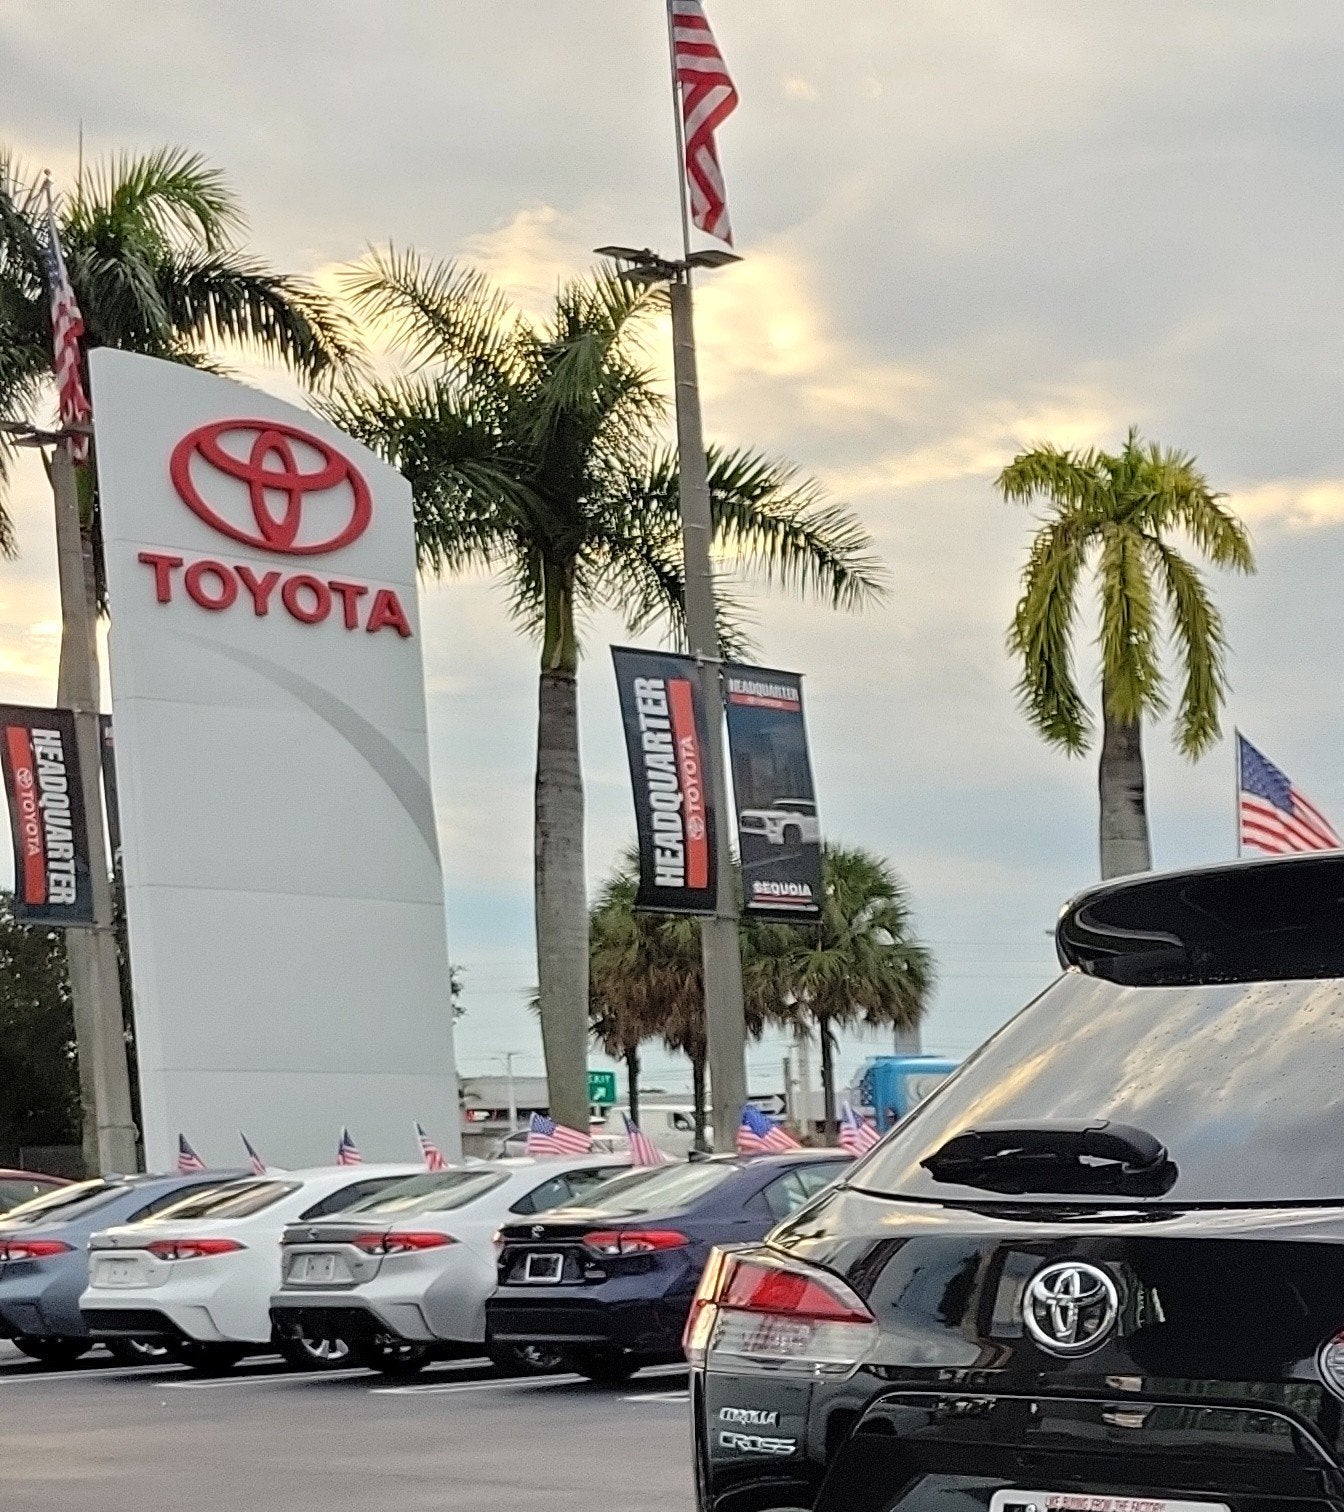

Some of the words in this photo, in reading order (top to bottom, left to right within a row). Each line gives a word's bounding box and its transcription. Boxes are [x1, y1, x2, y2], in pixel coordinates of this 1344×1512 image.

[138, 552, 412, 638] TOYOTA
[634, 676, 685, 888] HEADQUARTER
[679, 736, 705, 813] TOYOTA
[21, 790, 41, 857] TOYOTA
[31, 728, 77, 906] HEADQUARTER
[753, 881, 813, 897] SEQUOIA
[720, 1407, 779, 1426] COROLLA
[720, 1431, 797, 1455] CROSS
